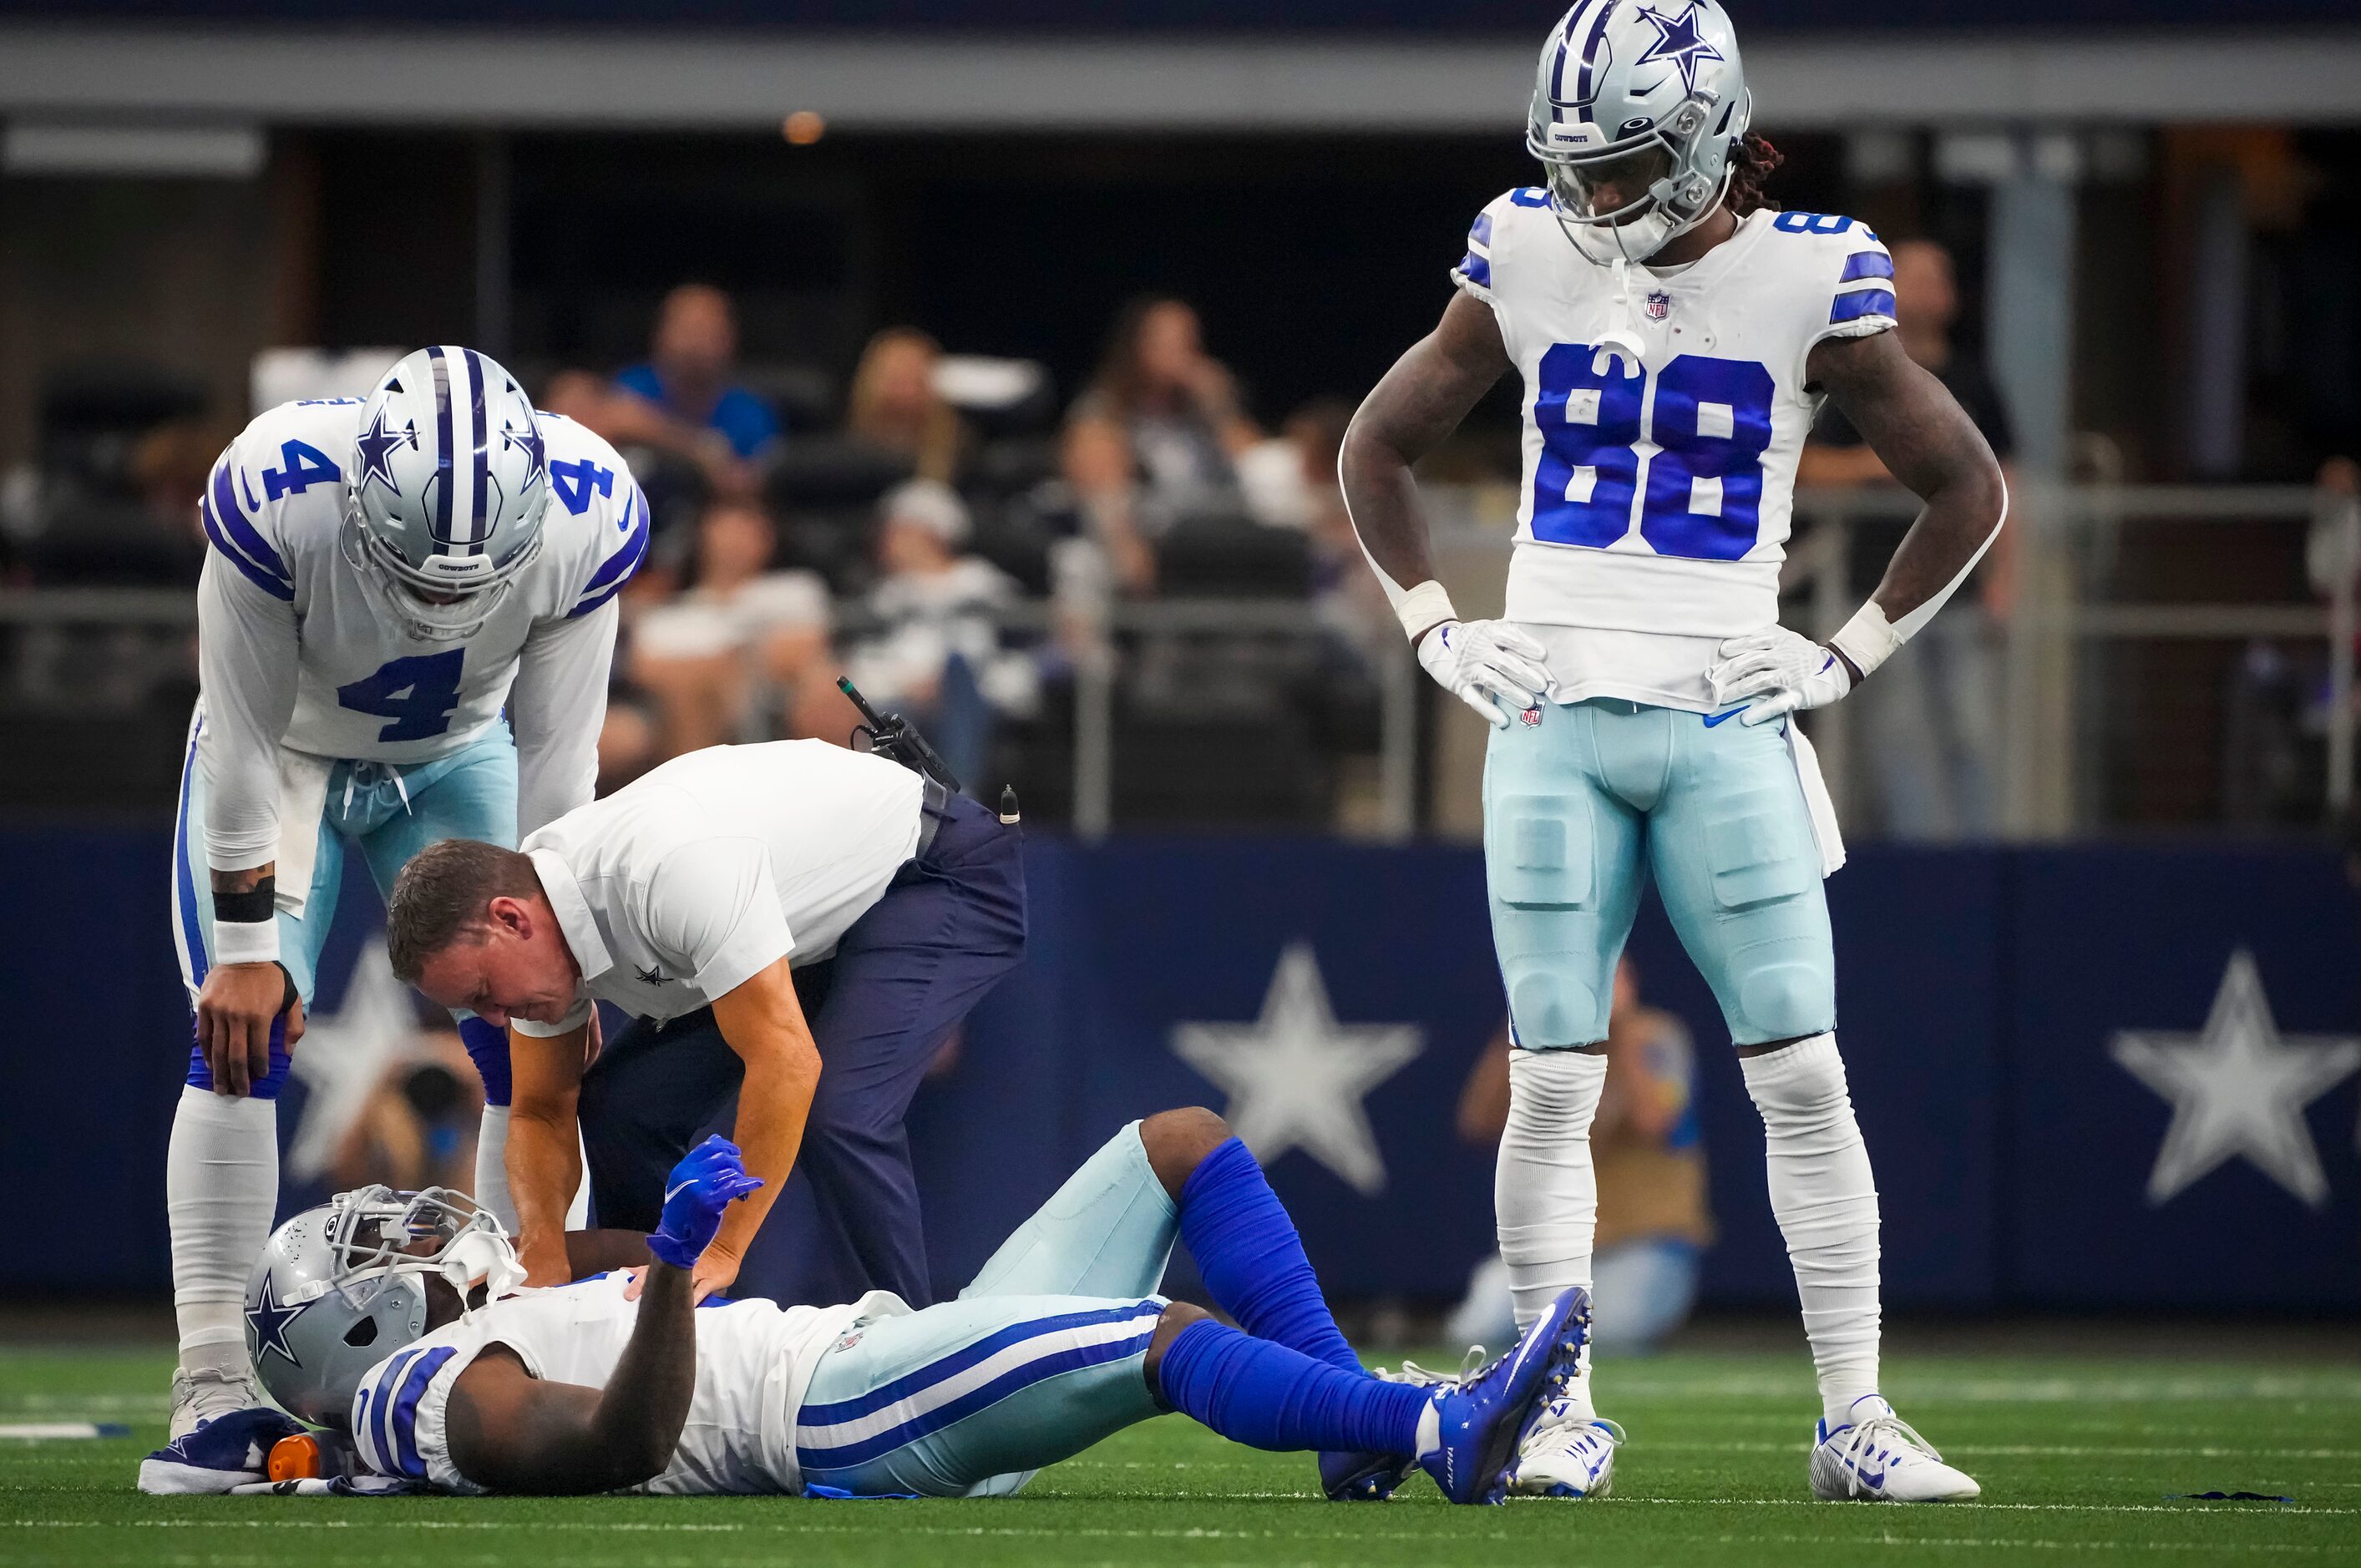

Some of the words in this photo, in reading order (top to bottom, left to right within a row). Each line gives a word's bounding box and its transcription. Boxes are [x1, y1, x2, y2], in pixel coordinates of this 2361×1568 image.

[1554, 134, 1588, 143] COWBOYS
[1649, 304, 1666, 316] NFL
[1531, 342, 1776, 561] 88
[261, 438, 341, 502] 4
[550, 458, 615, 516] 4
[438, 564, 479, 572] COWBOYS
[335, 647, 466, 742] 4
[1522, 710, 1539, 723] NFL
